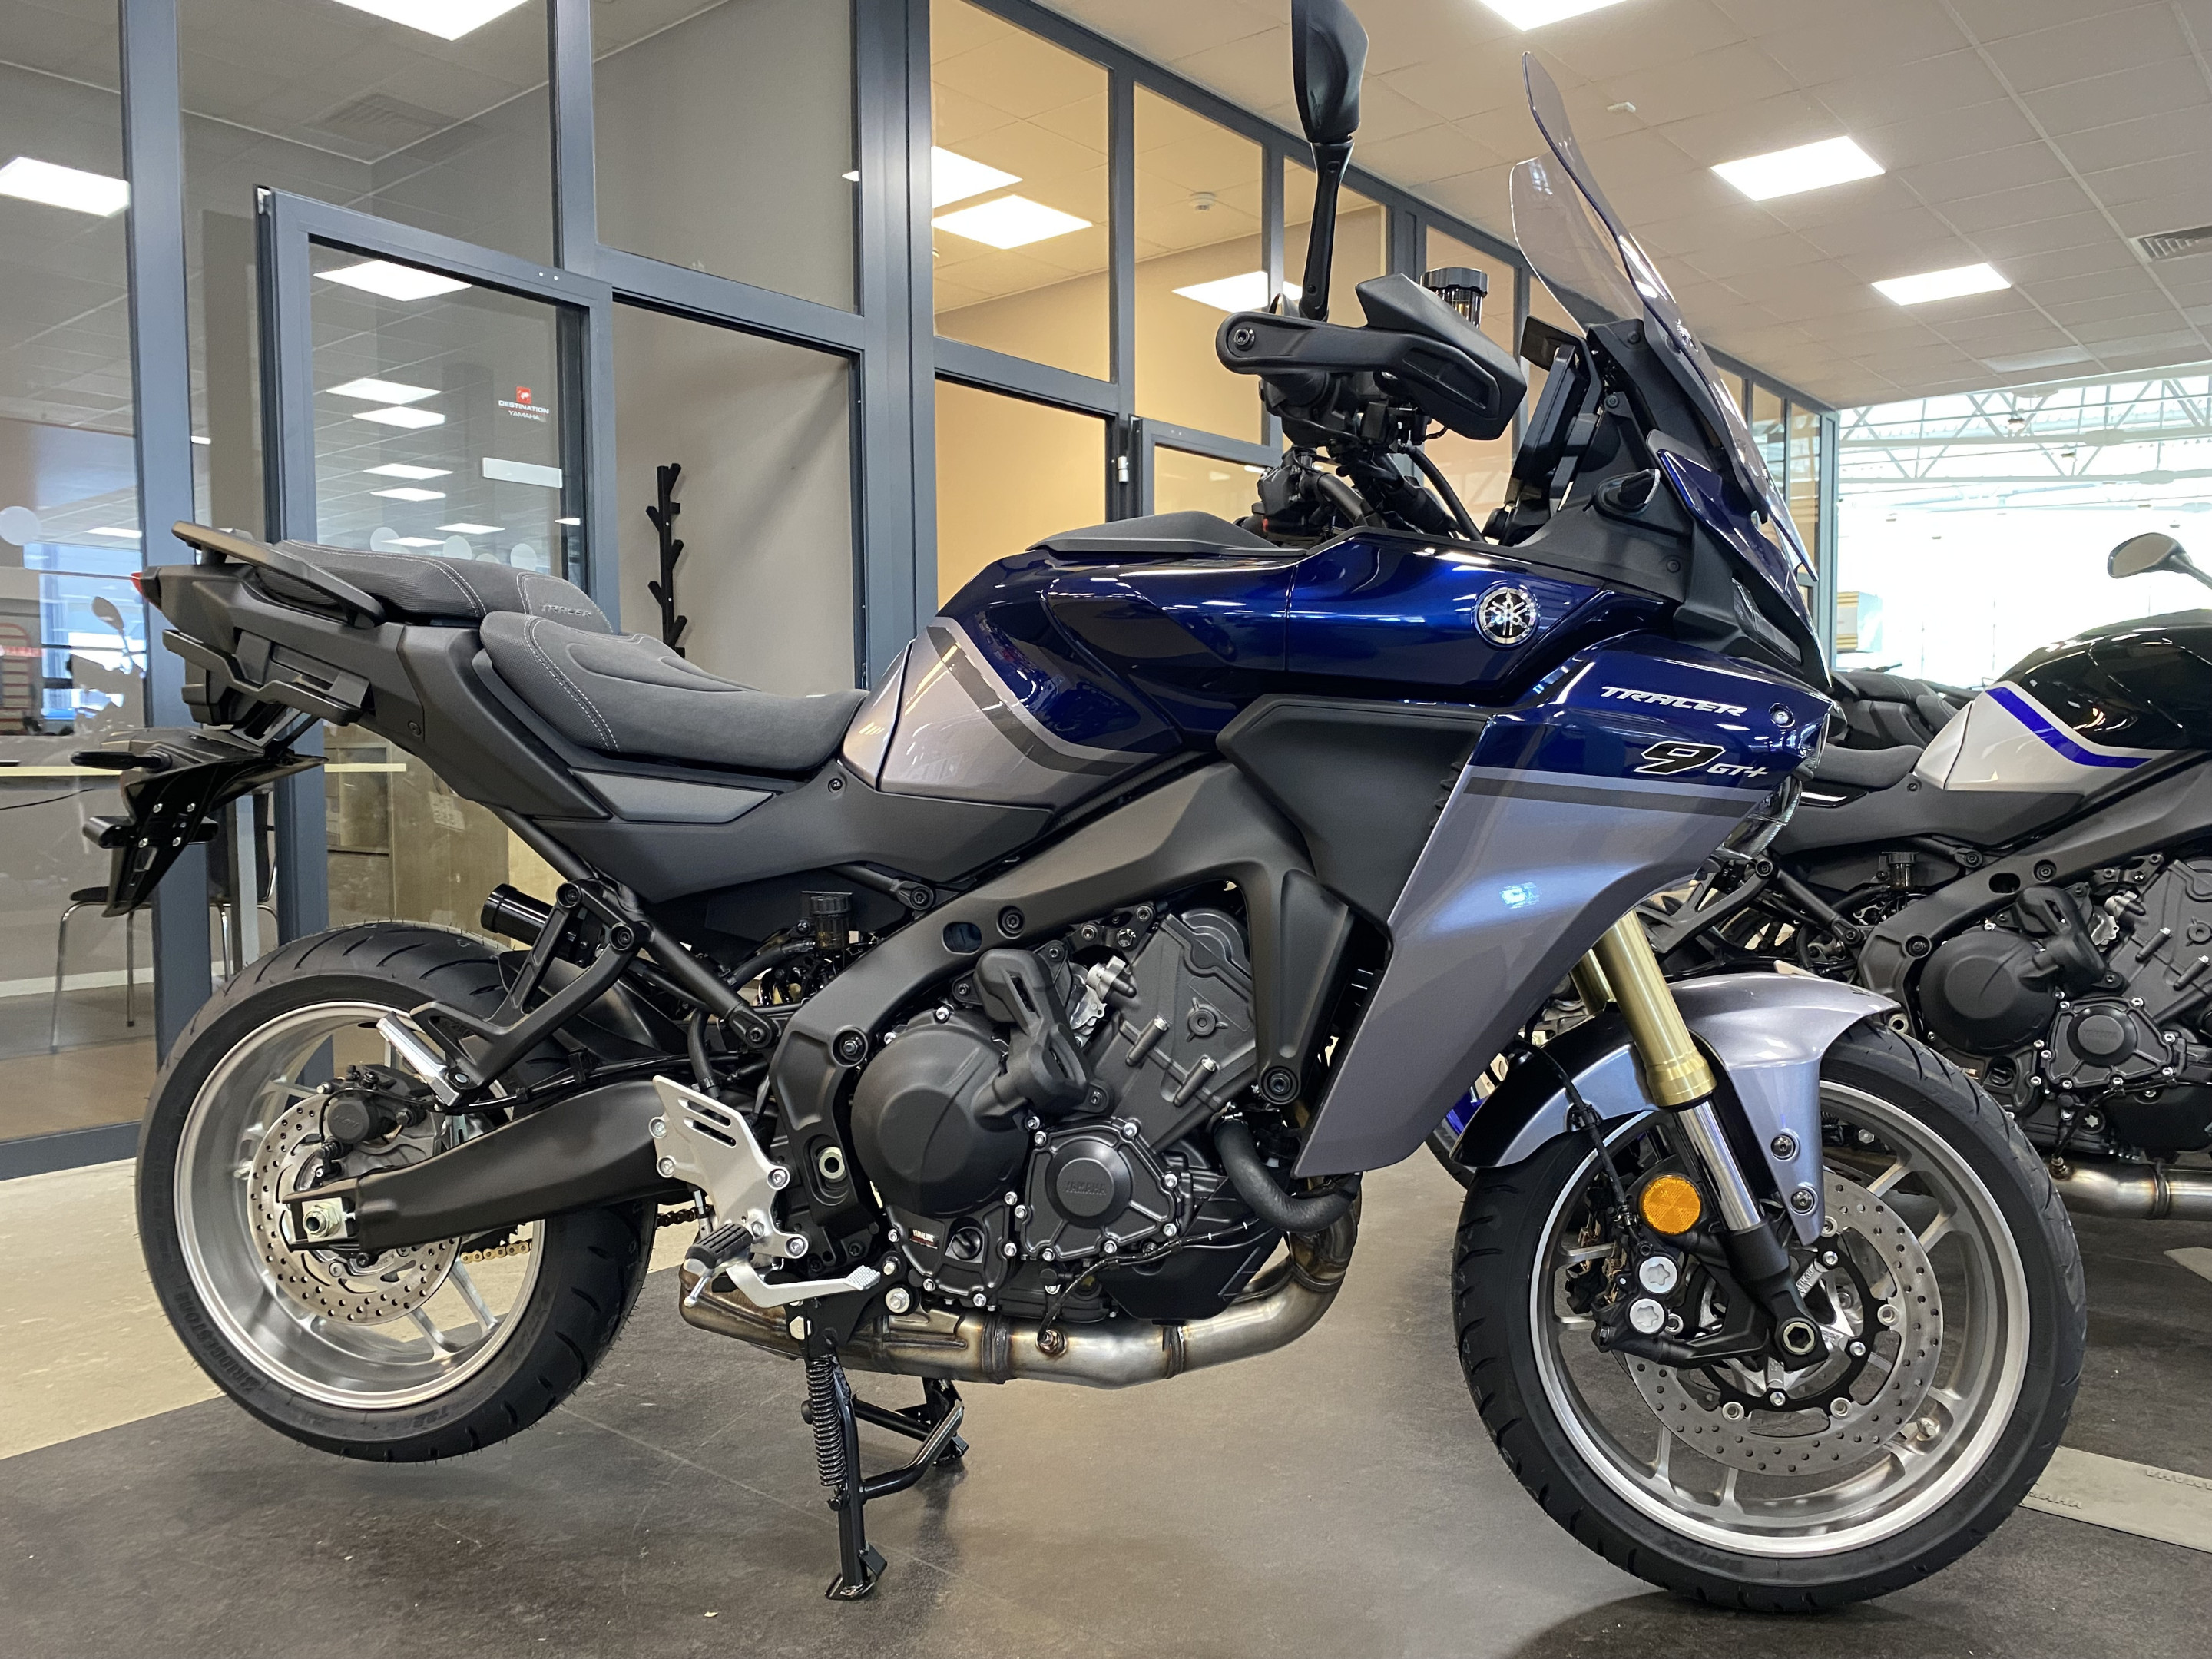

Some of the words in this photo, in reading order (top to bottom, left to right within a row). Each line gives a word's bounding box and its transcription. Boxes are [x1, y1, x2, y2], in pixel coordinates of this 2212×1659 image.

[498, 399, 550, 415] DESTINATION
[508, 409, 541, 422] YAMAHA
[1601, 685, 1749, 717] TRACER
[1633, 740, 1727, 776] 9
[1707, 763, 1770, 779] GT+
[1065, 1180, 1107, 1197] YAMAHA
[170, 1287, 260, 1398] BRIDGESTONE
